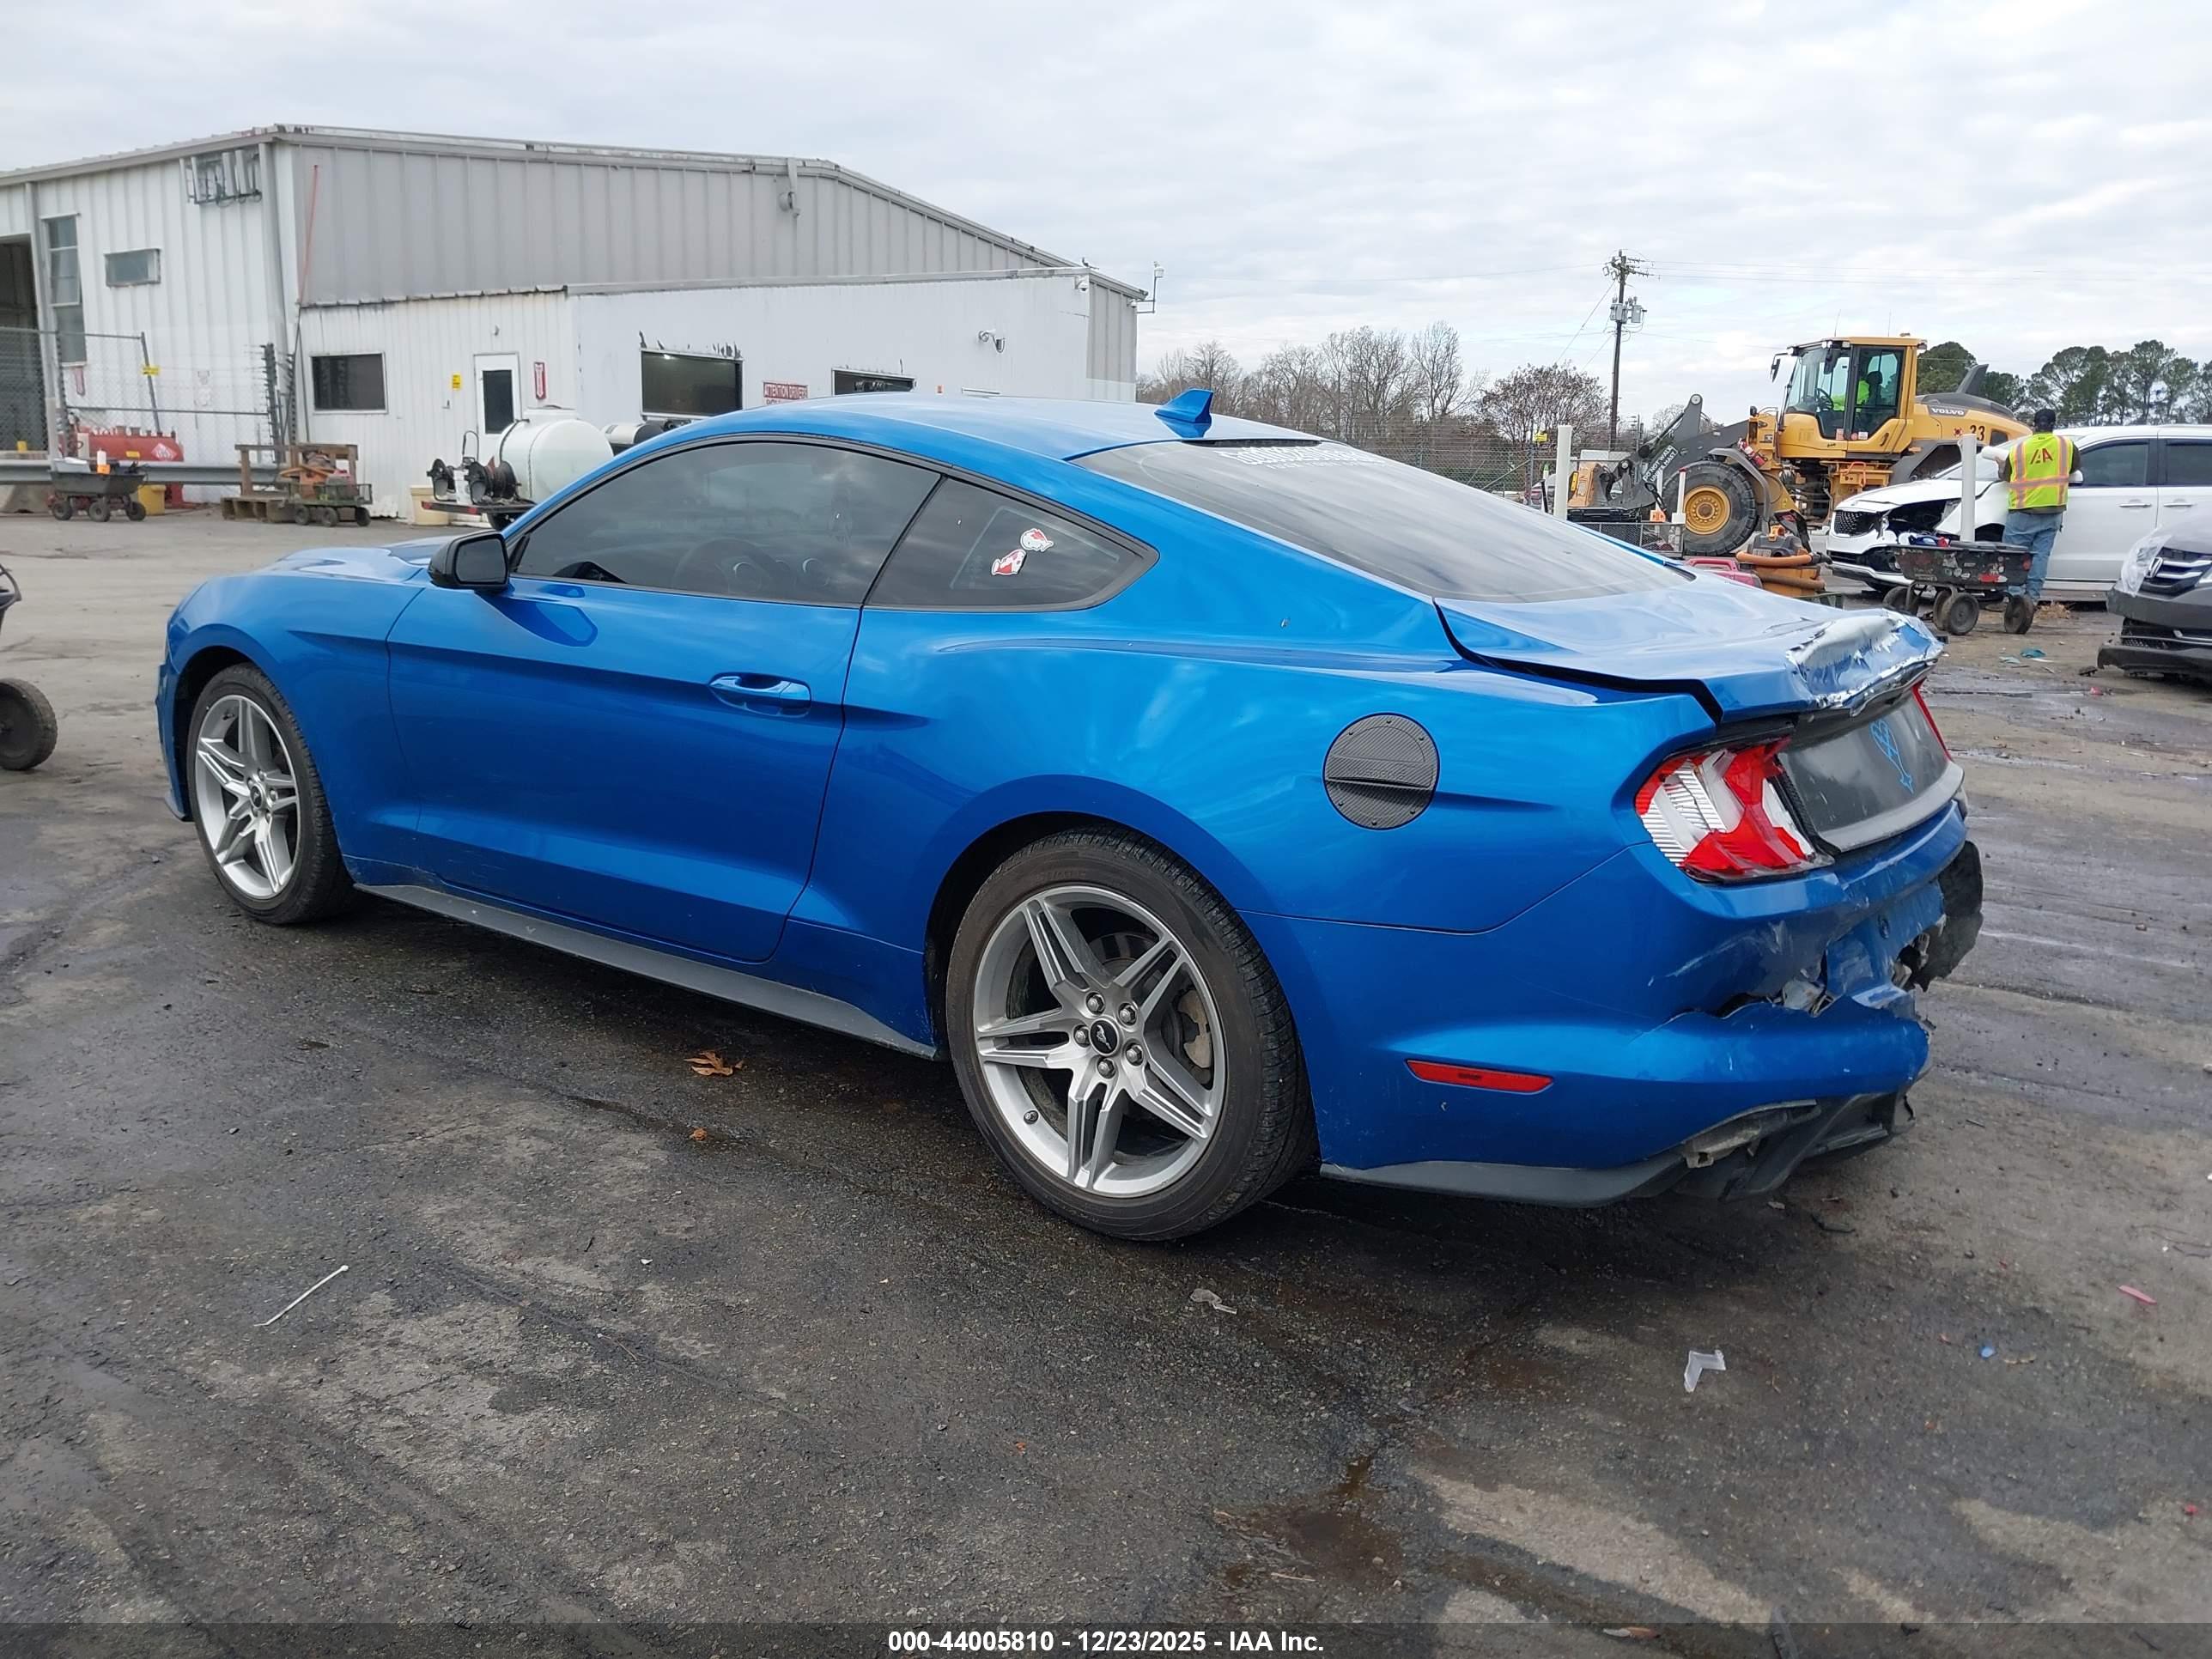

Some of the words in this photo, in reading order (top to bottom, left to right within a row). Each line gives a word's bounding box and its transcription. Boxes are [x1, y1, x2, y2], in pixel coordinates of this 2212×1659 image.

[1931, 407, 1965, 416] VOLVO
[1659, 445, 1674, 460] WALK
[1663, 451, 1677, 465] MAST
